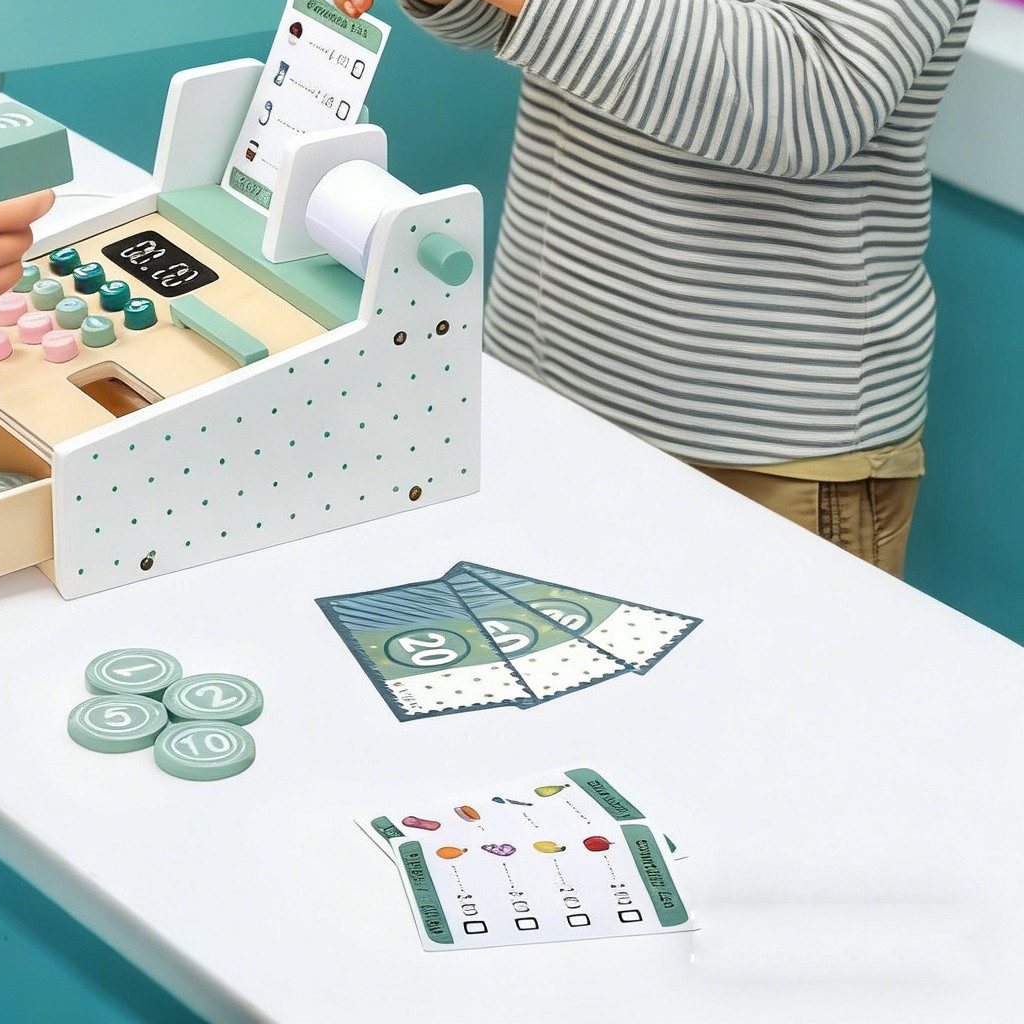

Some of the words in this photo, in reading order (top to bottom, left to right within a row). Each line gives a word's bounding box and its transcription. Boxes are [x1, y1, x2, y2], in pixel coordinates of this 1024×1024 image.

[397, 632, 458, 667] 20
[196, 685, 238, 708] 2
[103, 706, 132, 727] 5
[179, 733, 231, 756] 10
